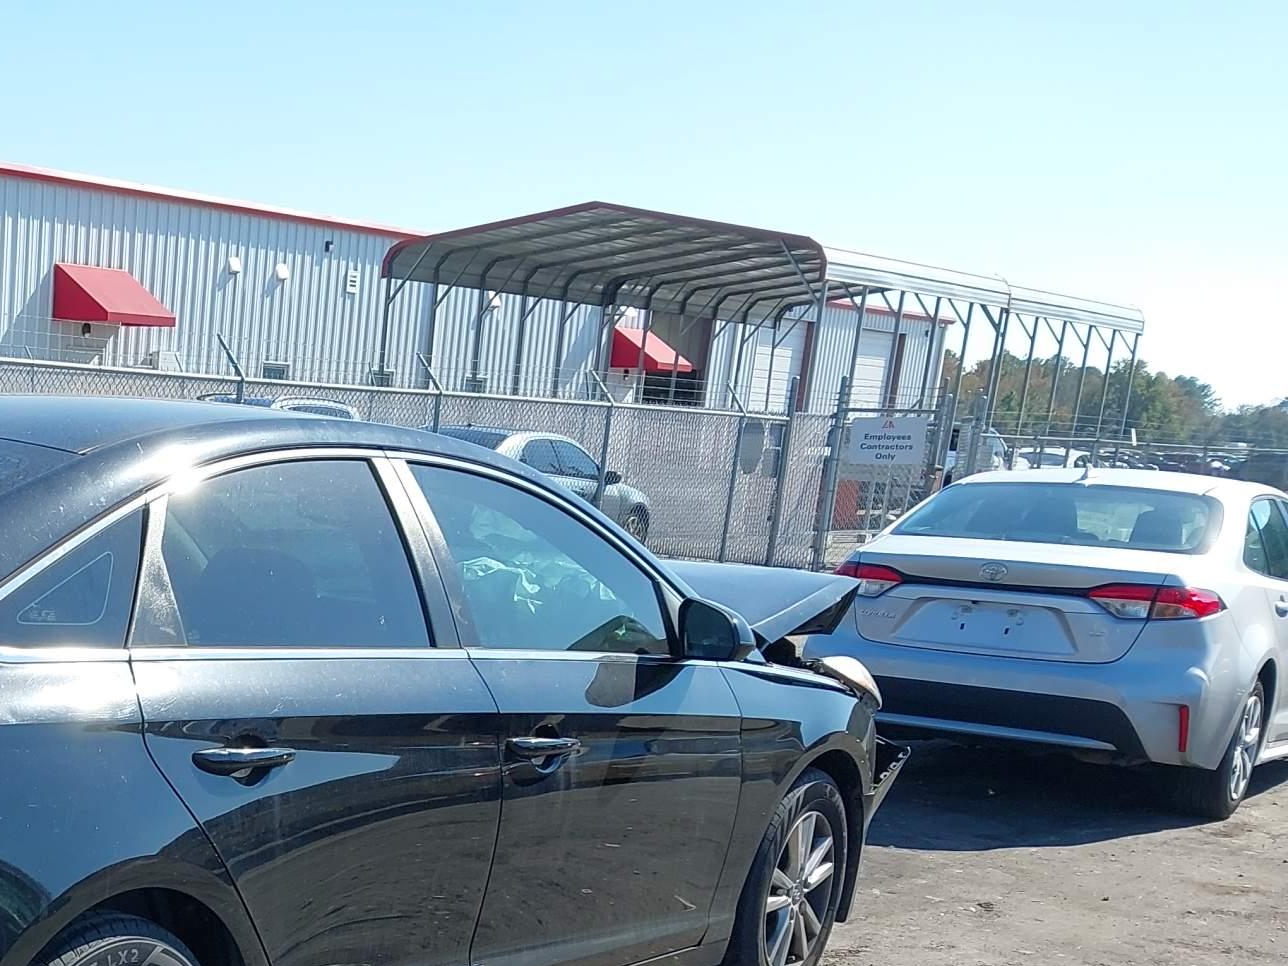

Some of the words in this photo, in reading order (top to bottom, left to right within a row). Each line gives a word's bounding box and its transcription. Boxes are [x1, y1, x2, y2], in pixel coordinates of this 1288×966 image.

[864, 433, 912, 442] Employees
[860, 442, 913, 450] Contractors
[875, 452, 896, 460] Only
